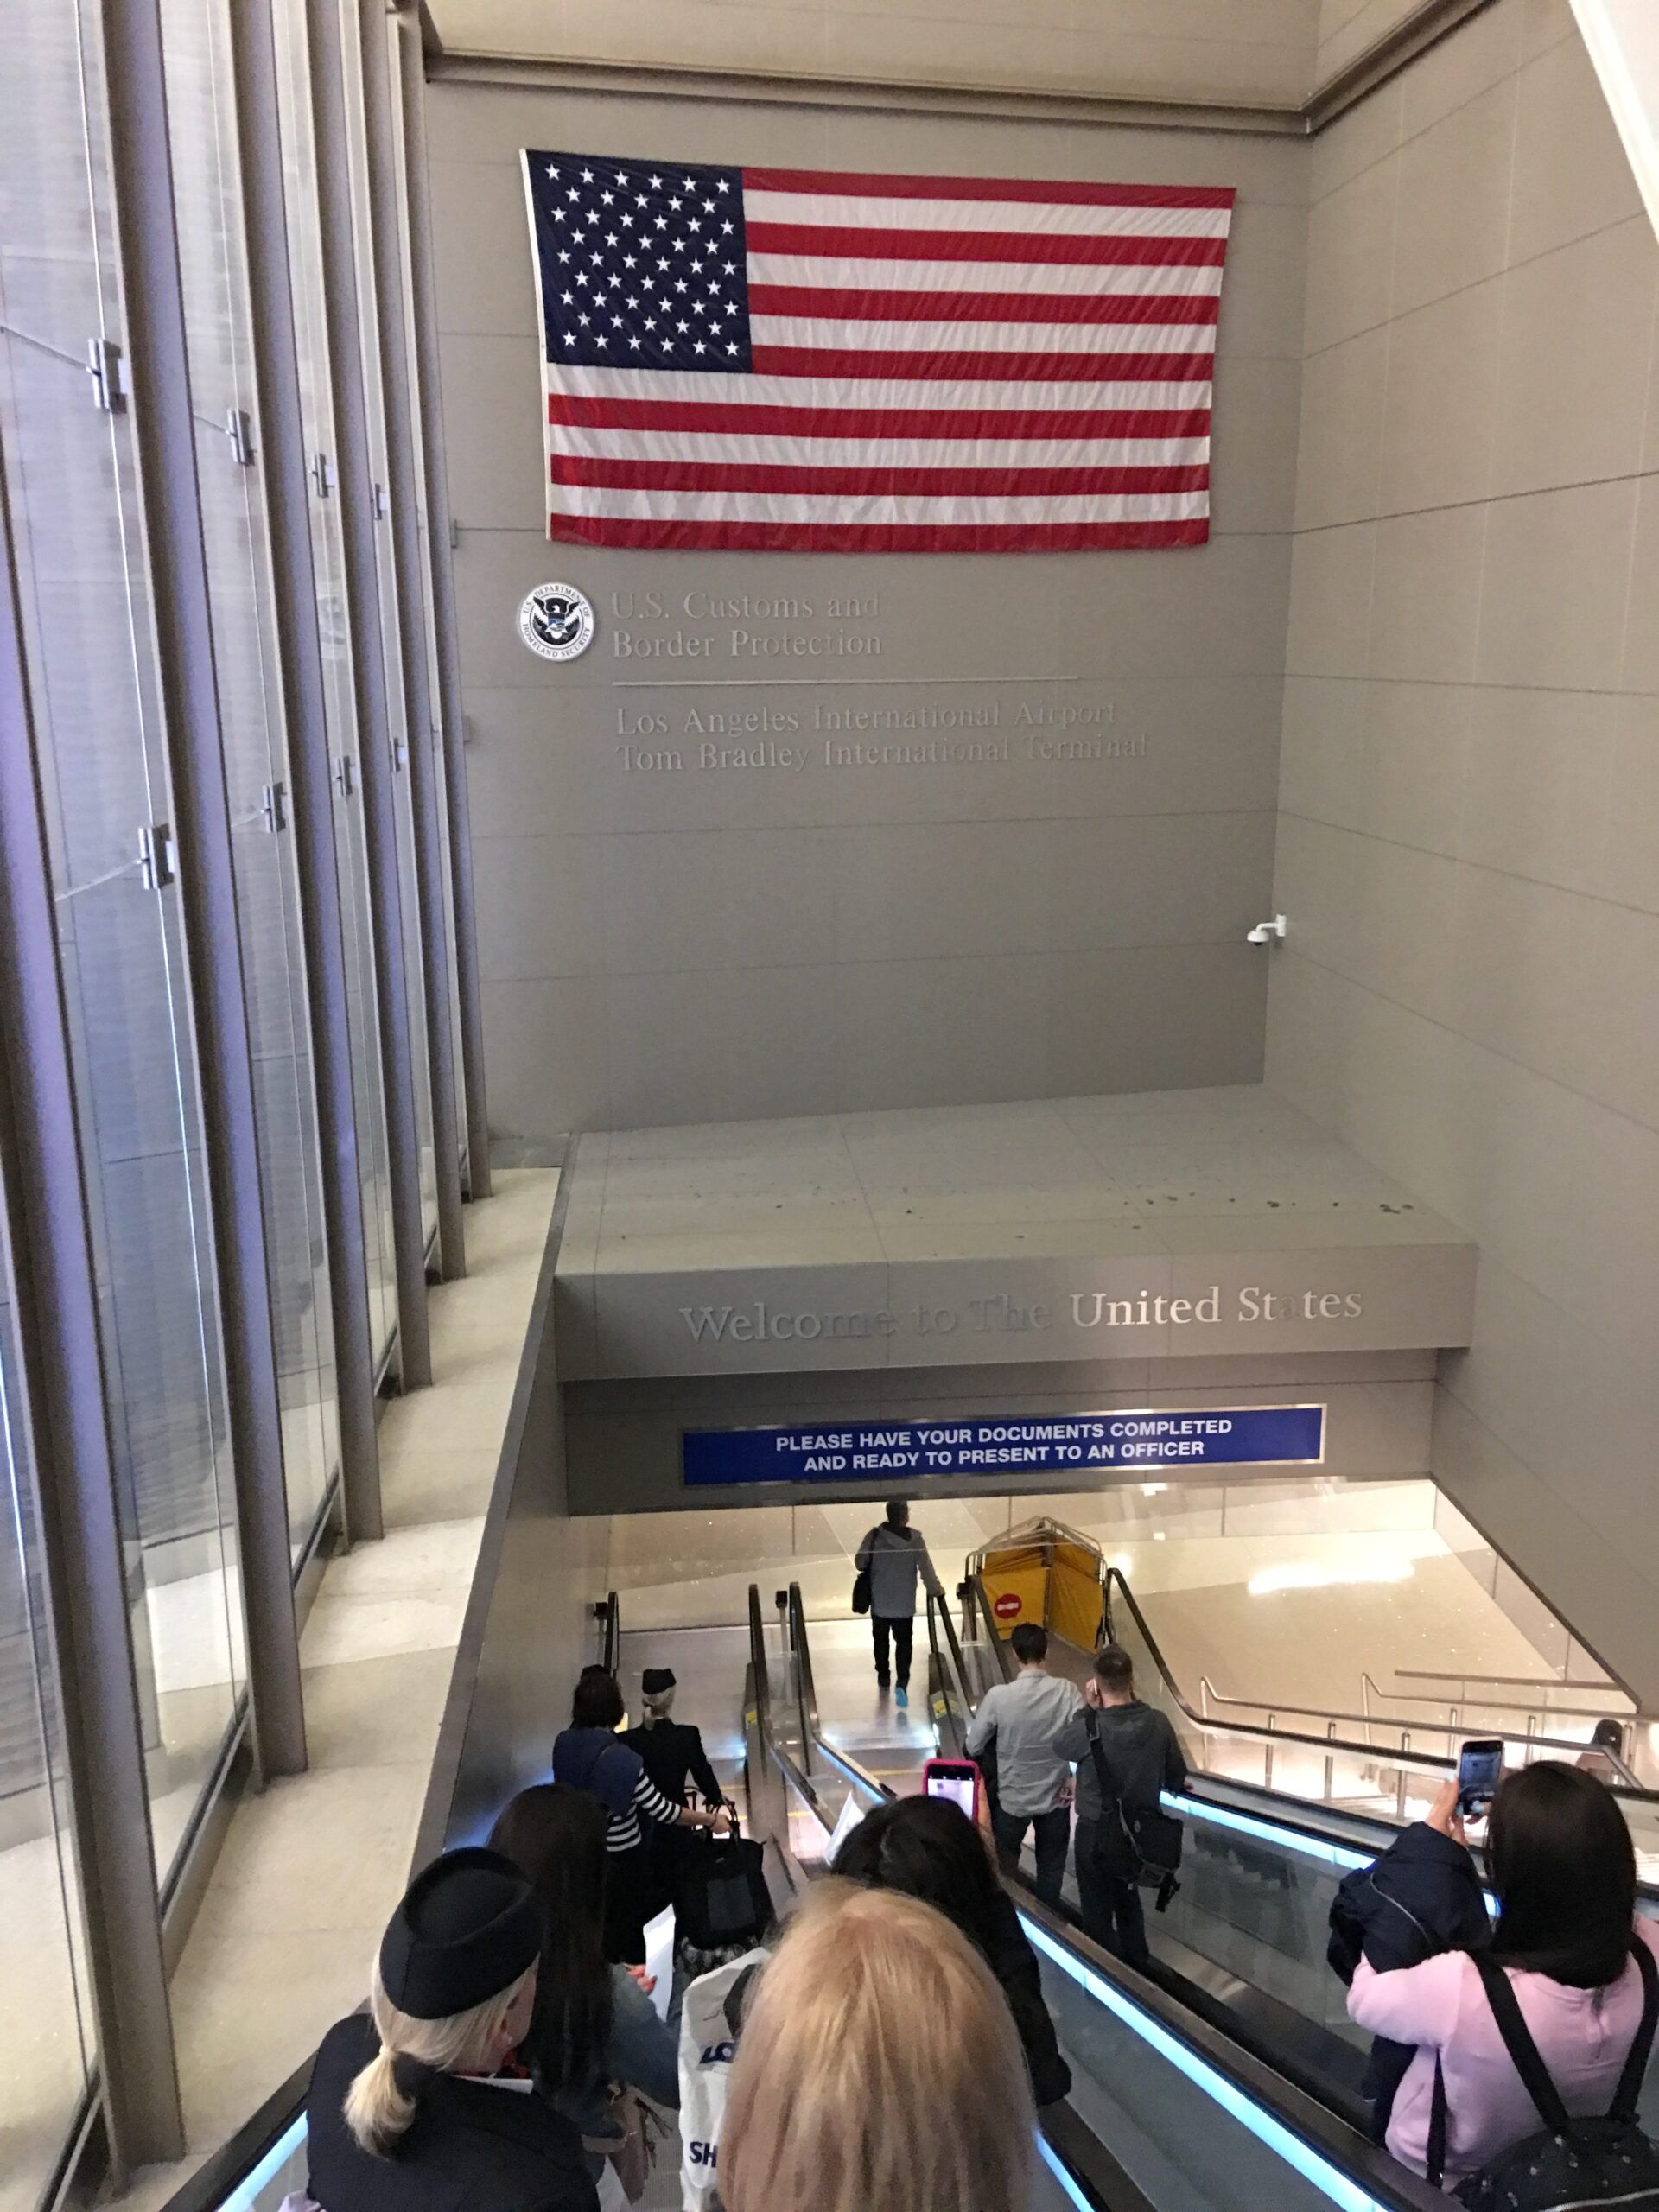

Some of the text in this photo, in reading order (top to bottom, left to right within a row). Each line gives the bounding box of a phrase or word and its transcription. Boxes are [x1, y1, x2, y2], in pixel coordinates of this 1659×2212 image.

[534, 585, 584, 606] DEPARTMENT
[582, 607, 591, 617] OF
[611, 591, 880, 620] U.S. Customs and
[523, 623, 591, 657] HOMELAND SECURITY
[612, 628, 882, 658] Border Protection
[616, 701, 1116, 737] Los Angeles International Airport
[616, 734, 1151, 772] Tom Bradley International Terminal
[679, 1285, 1363, 1343] Welcome to The United States
[776, 1419, 1233, 1452] PLEASE HAVE YOUR DOCUMENTS COMPLETED
[804, 1440, 1205, 1472] AND READY TO PRESENT TO AN OFFICER
